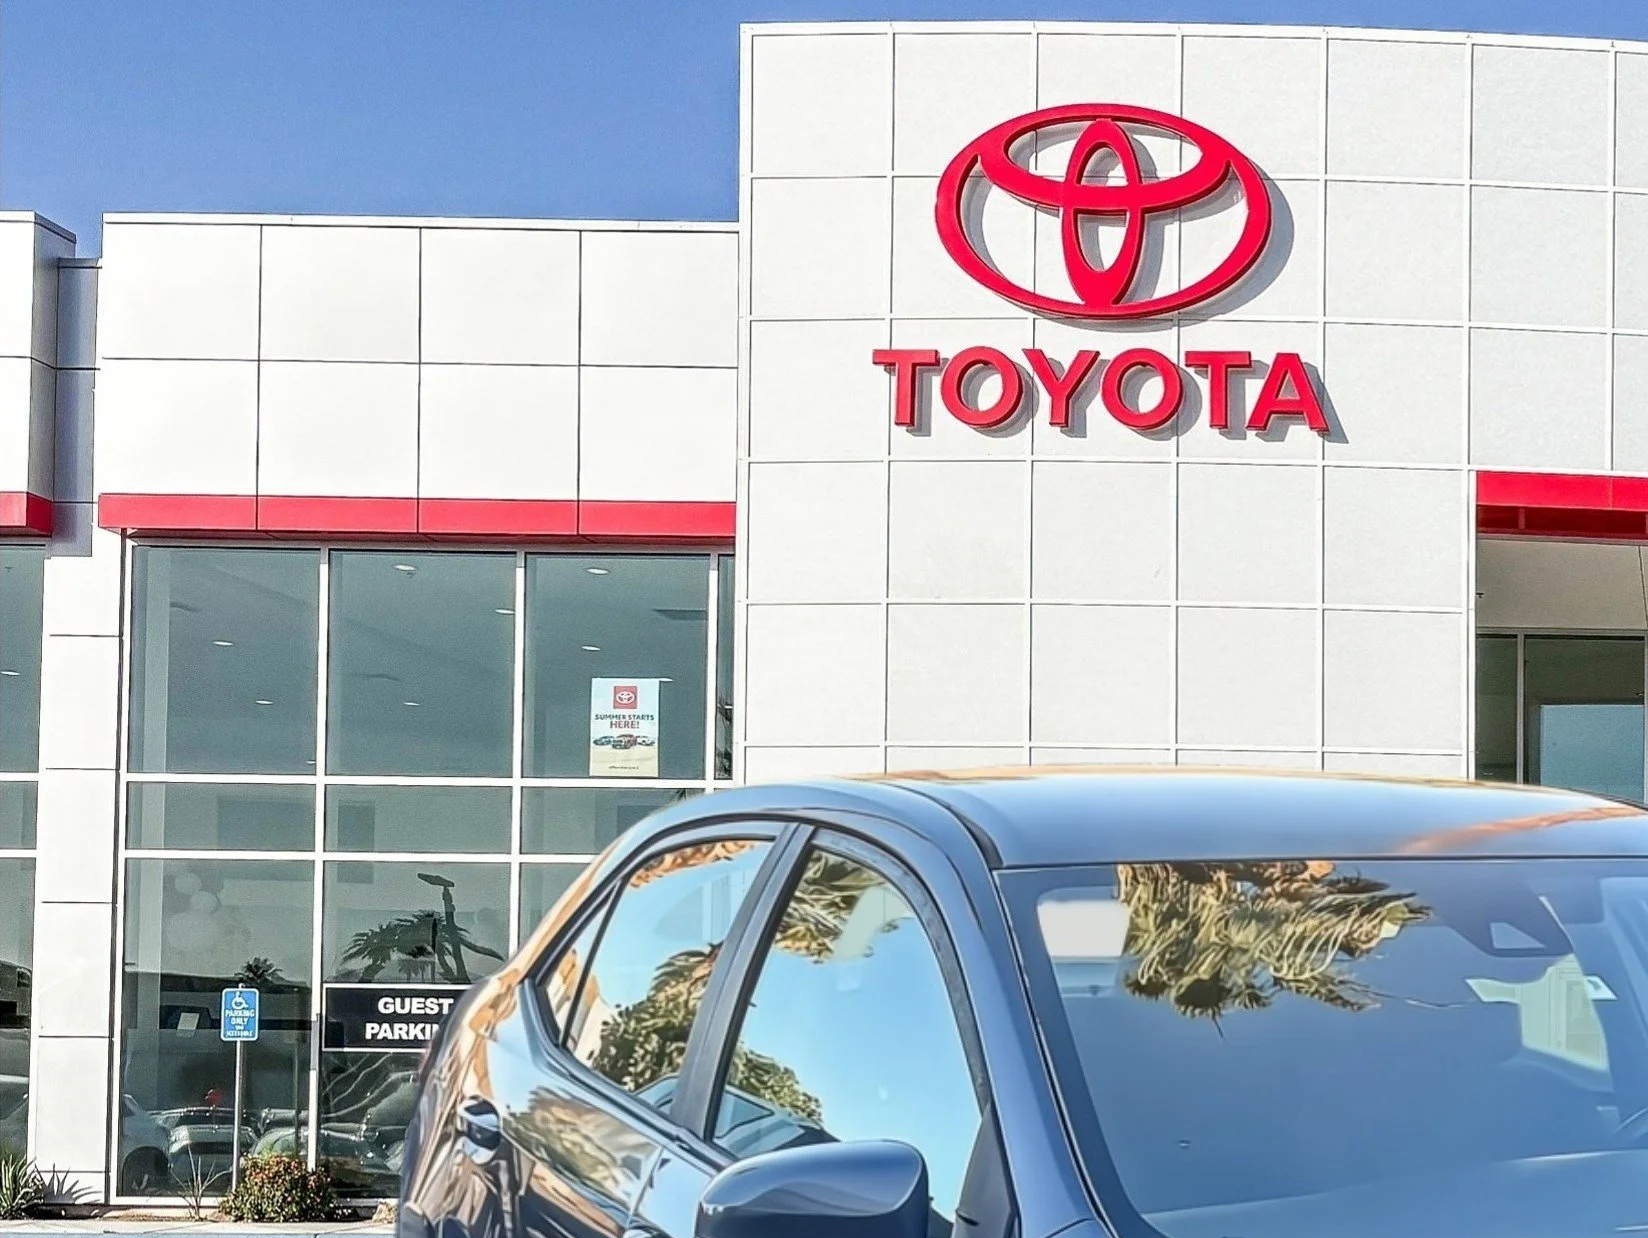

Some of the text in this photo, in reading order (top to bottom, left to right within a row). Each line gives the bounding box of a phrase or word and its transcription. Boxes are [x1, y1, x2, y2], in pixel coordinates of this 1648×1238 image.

[872, 346, 1331, 435] TOYOTA
[609, 720, 640, 729] HERE!
[377, 996, 454, 1015] GUEST
[225, 1009, 255, 1018] PARKING
[230, 1017, 249, 1026] ONLY
[365, 1022, 440, 1041] PARKI
